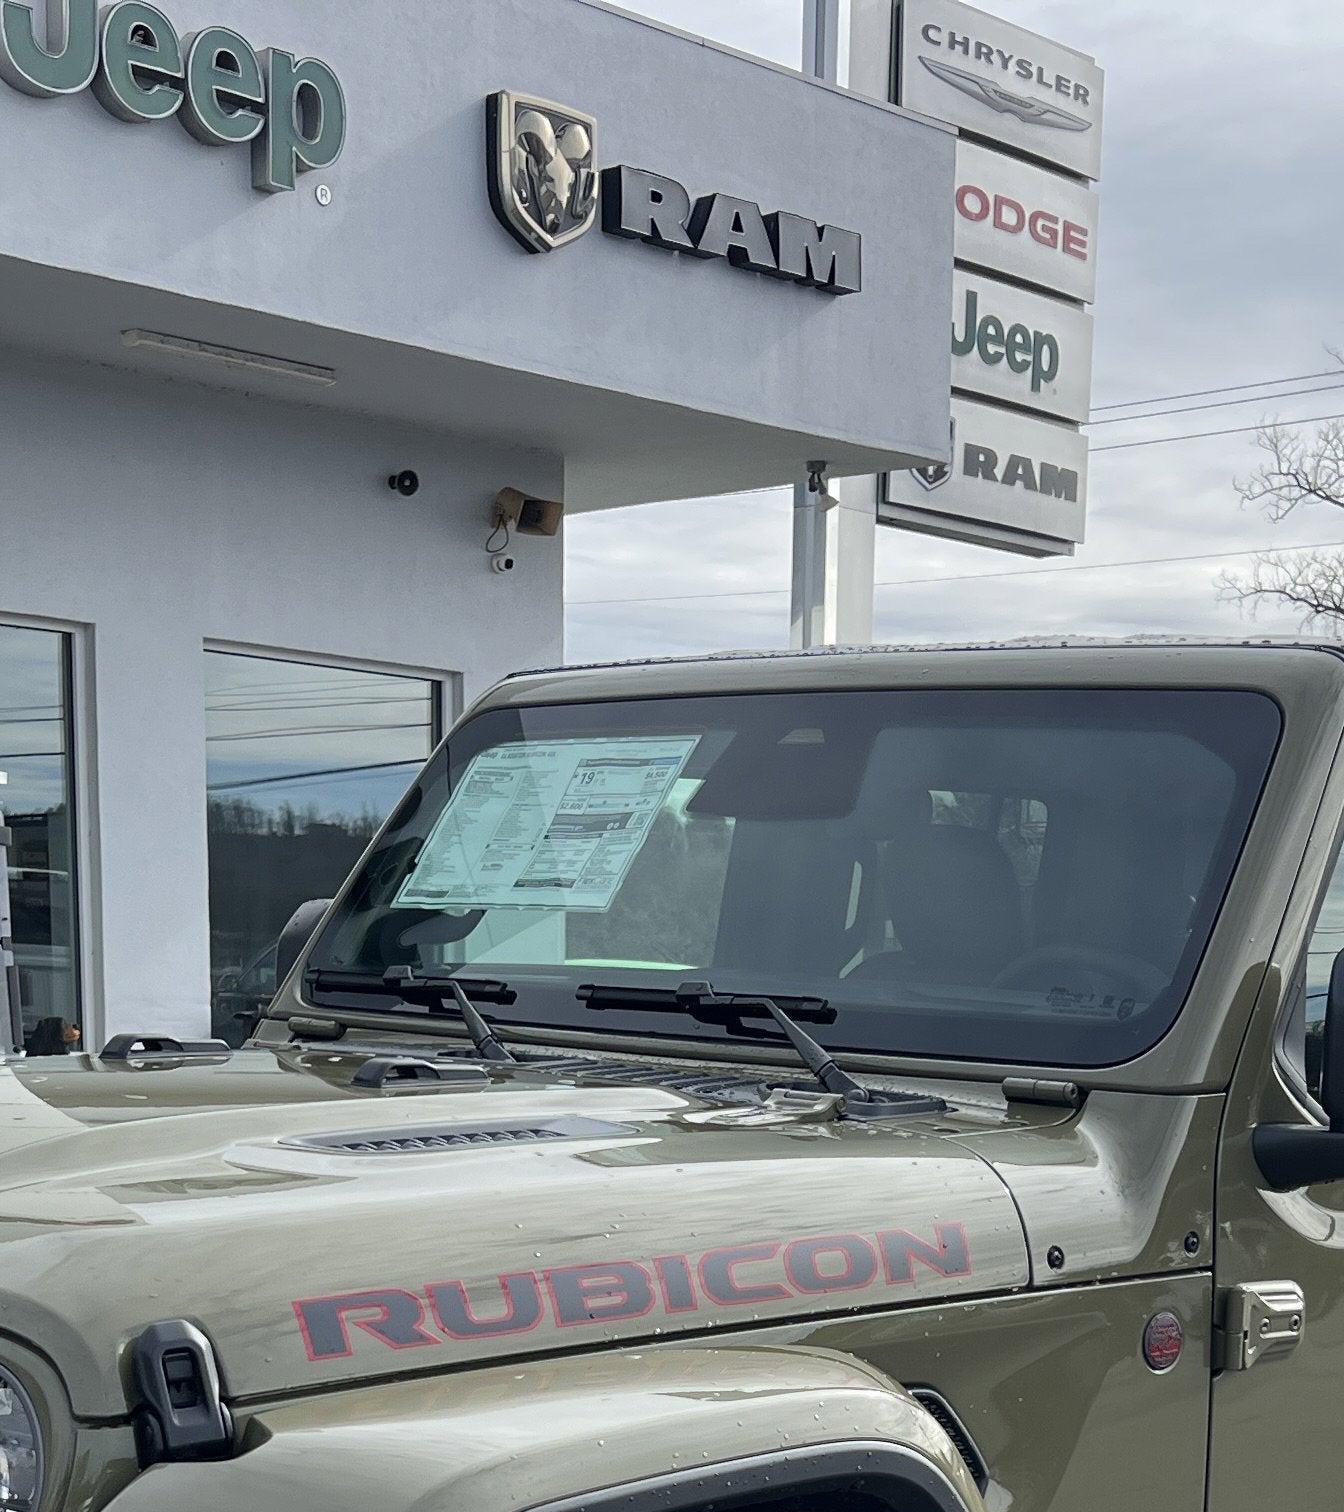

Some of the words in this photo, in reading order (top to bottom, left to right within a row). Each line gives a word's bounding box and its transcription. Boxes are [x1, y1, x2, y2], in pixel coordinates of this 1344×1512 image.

[921, 24, 1090, 105] CHRYSLER
[602, 164, 862, 296] RAM
[951, 289, 1059, 393] Jeep
[963, 442, 1078, 503] RAM
[292, 1222, 973, 1362] RUBICON
